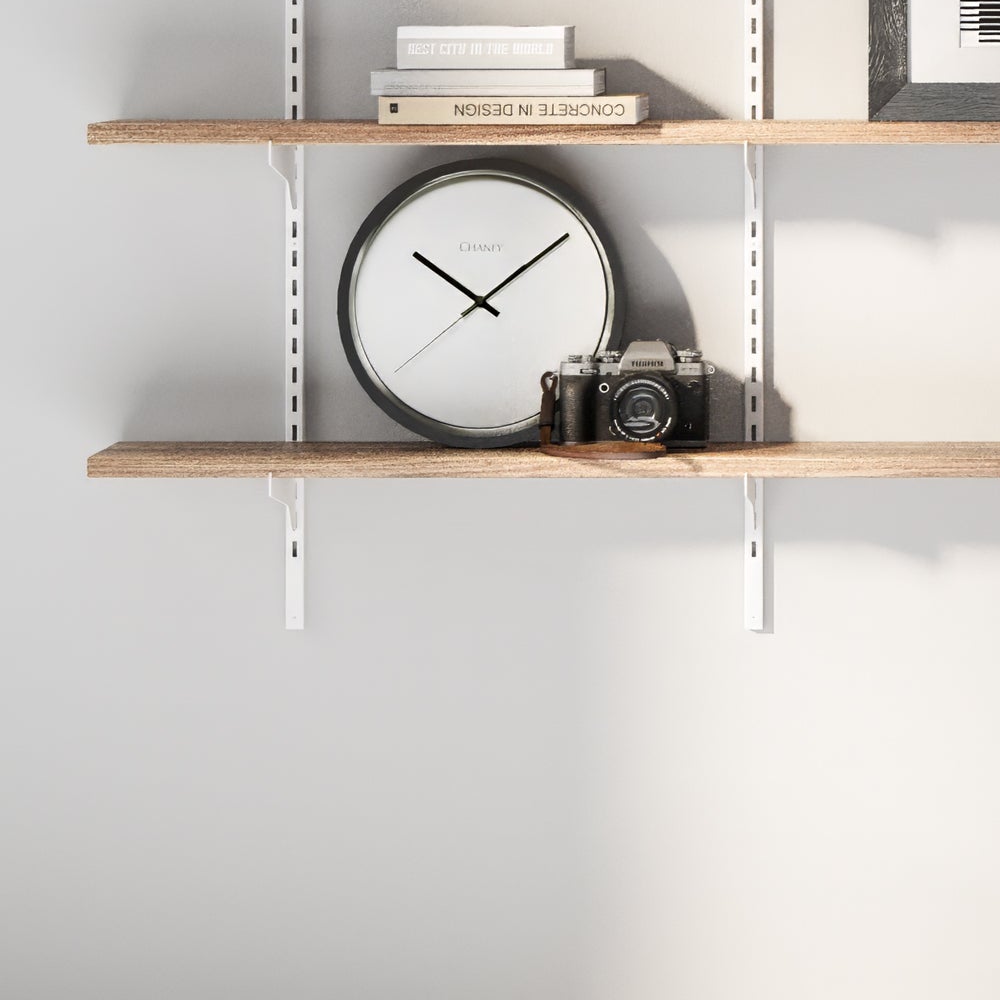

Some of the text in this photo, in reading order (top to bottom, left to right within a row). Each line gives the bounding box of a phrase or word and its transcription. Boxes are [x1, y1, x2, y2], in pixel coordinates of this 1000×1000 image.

[454, 103, 625, 117] CONCRETE IN DESIGN
